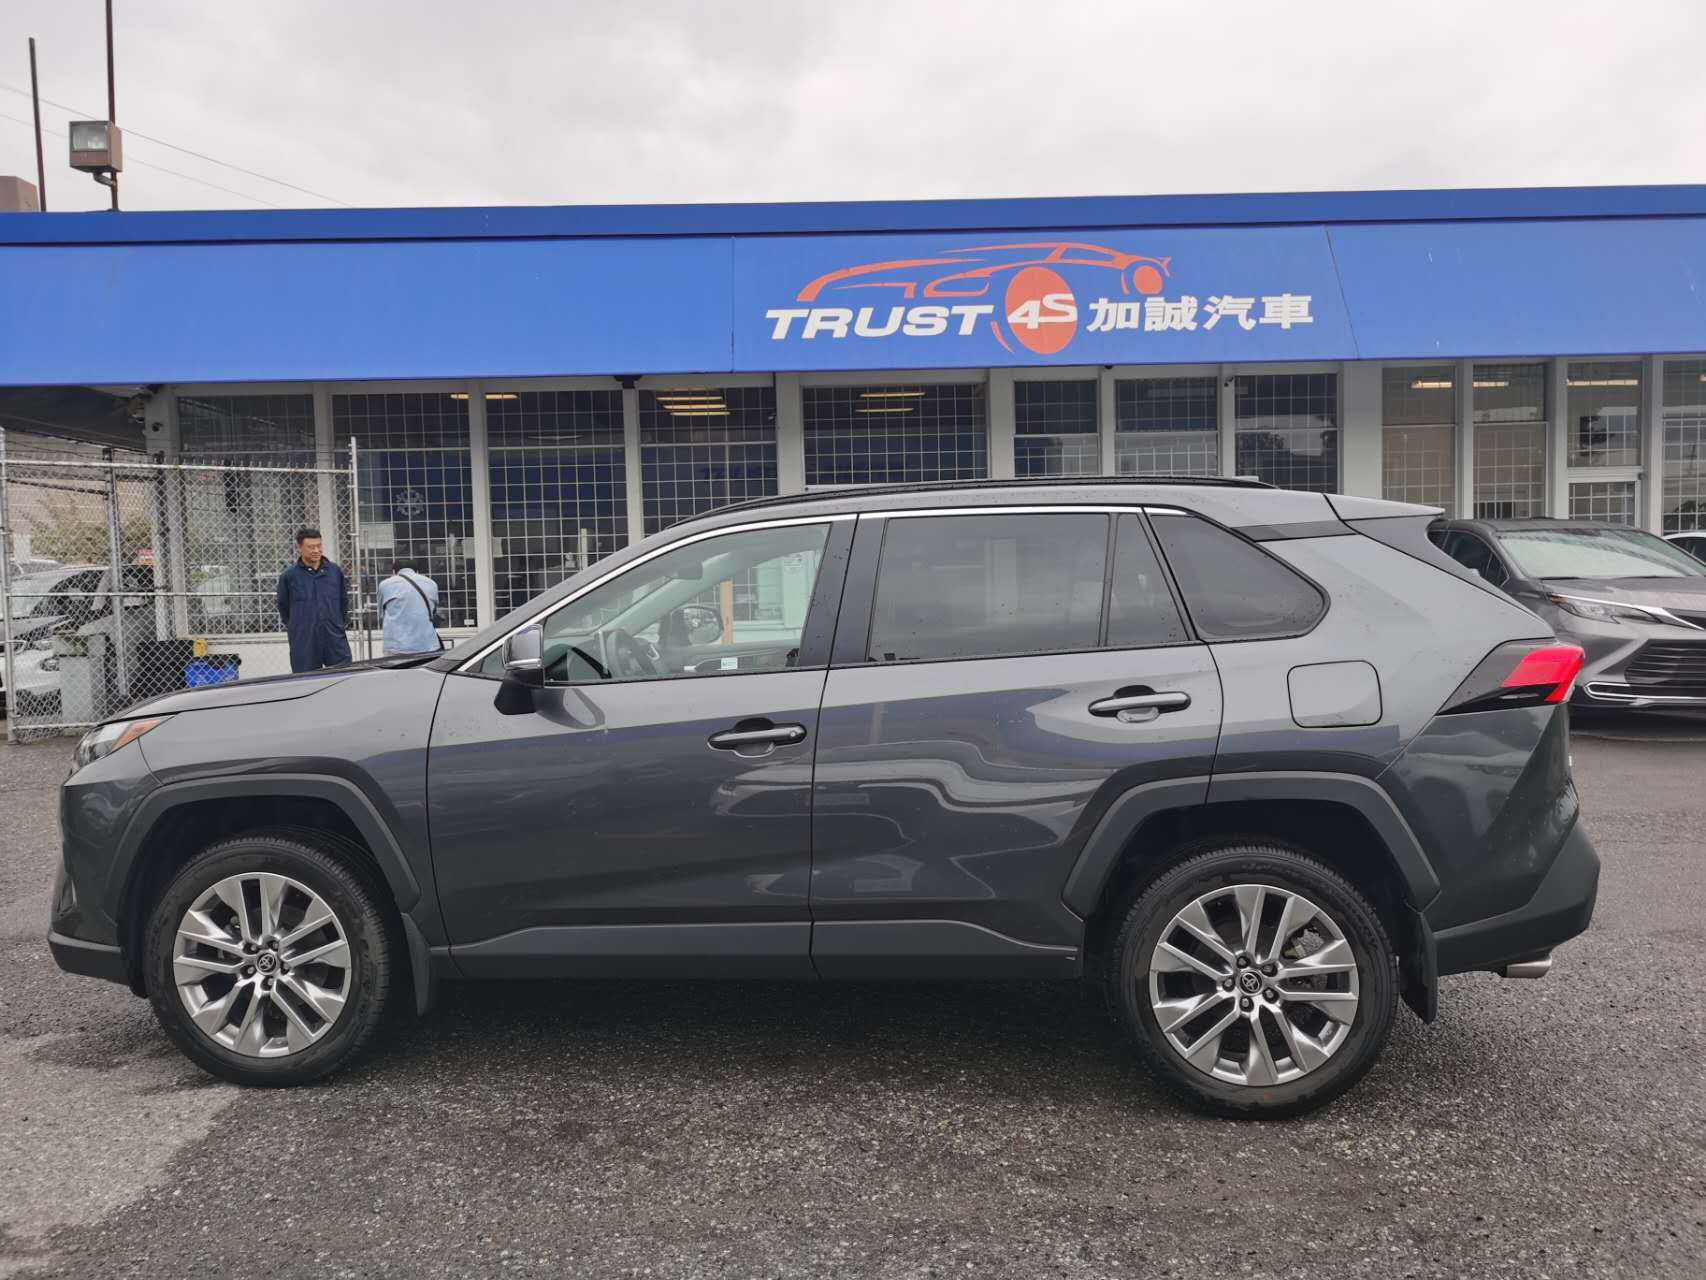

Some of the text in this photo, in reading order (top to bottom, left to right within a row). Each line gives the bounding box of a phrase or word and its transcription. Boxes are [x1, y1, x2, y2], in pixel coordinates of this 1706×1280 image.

[766, 293, 1078, 340] TRUST 4S
[1087, 293, 1314, 332] 加誠汽車
